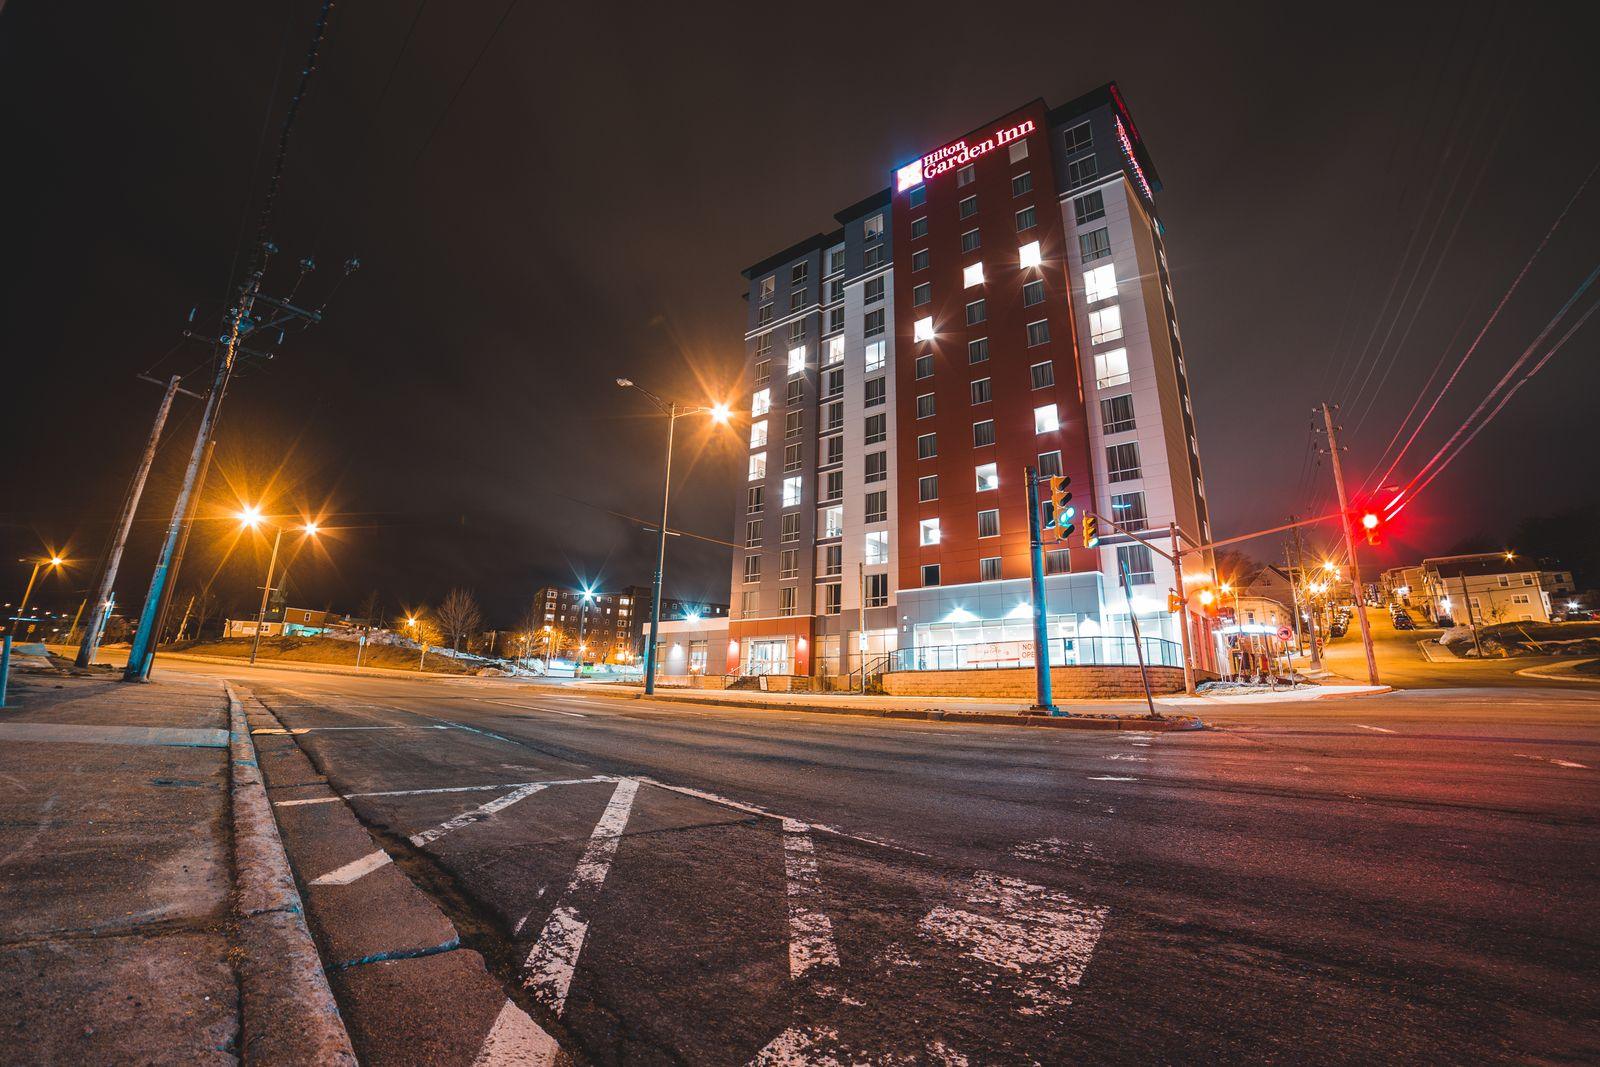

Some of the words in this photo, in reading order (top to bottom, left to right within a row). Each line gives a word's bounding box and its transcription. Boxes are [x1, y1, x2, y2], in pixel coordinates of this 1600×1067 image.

[923, 139, 995, 179] Garden
[995, 120, 1036, 147] Inn
[923, 140, 967, 168] Hilton
